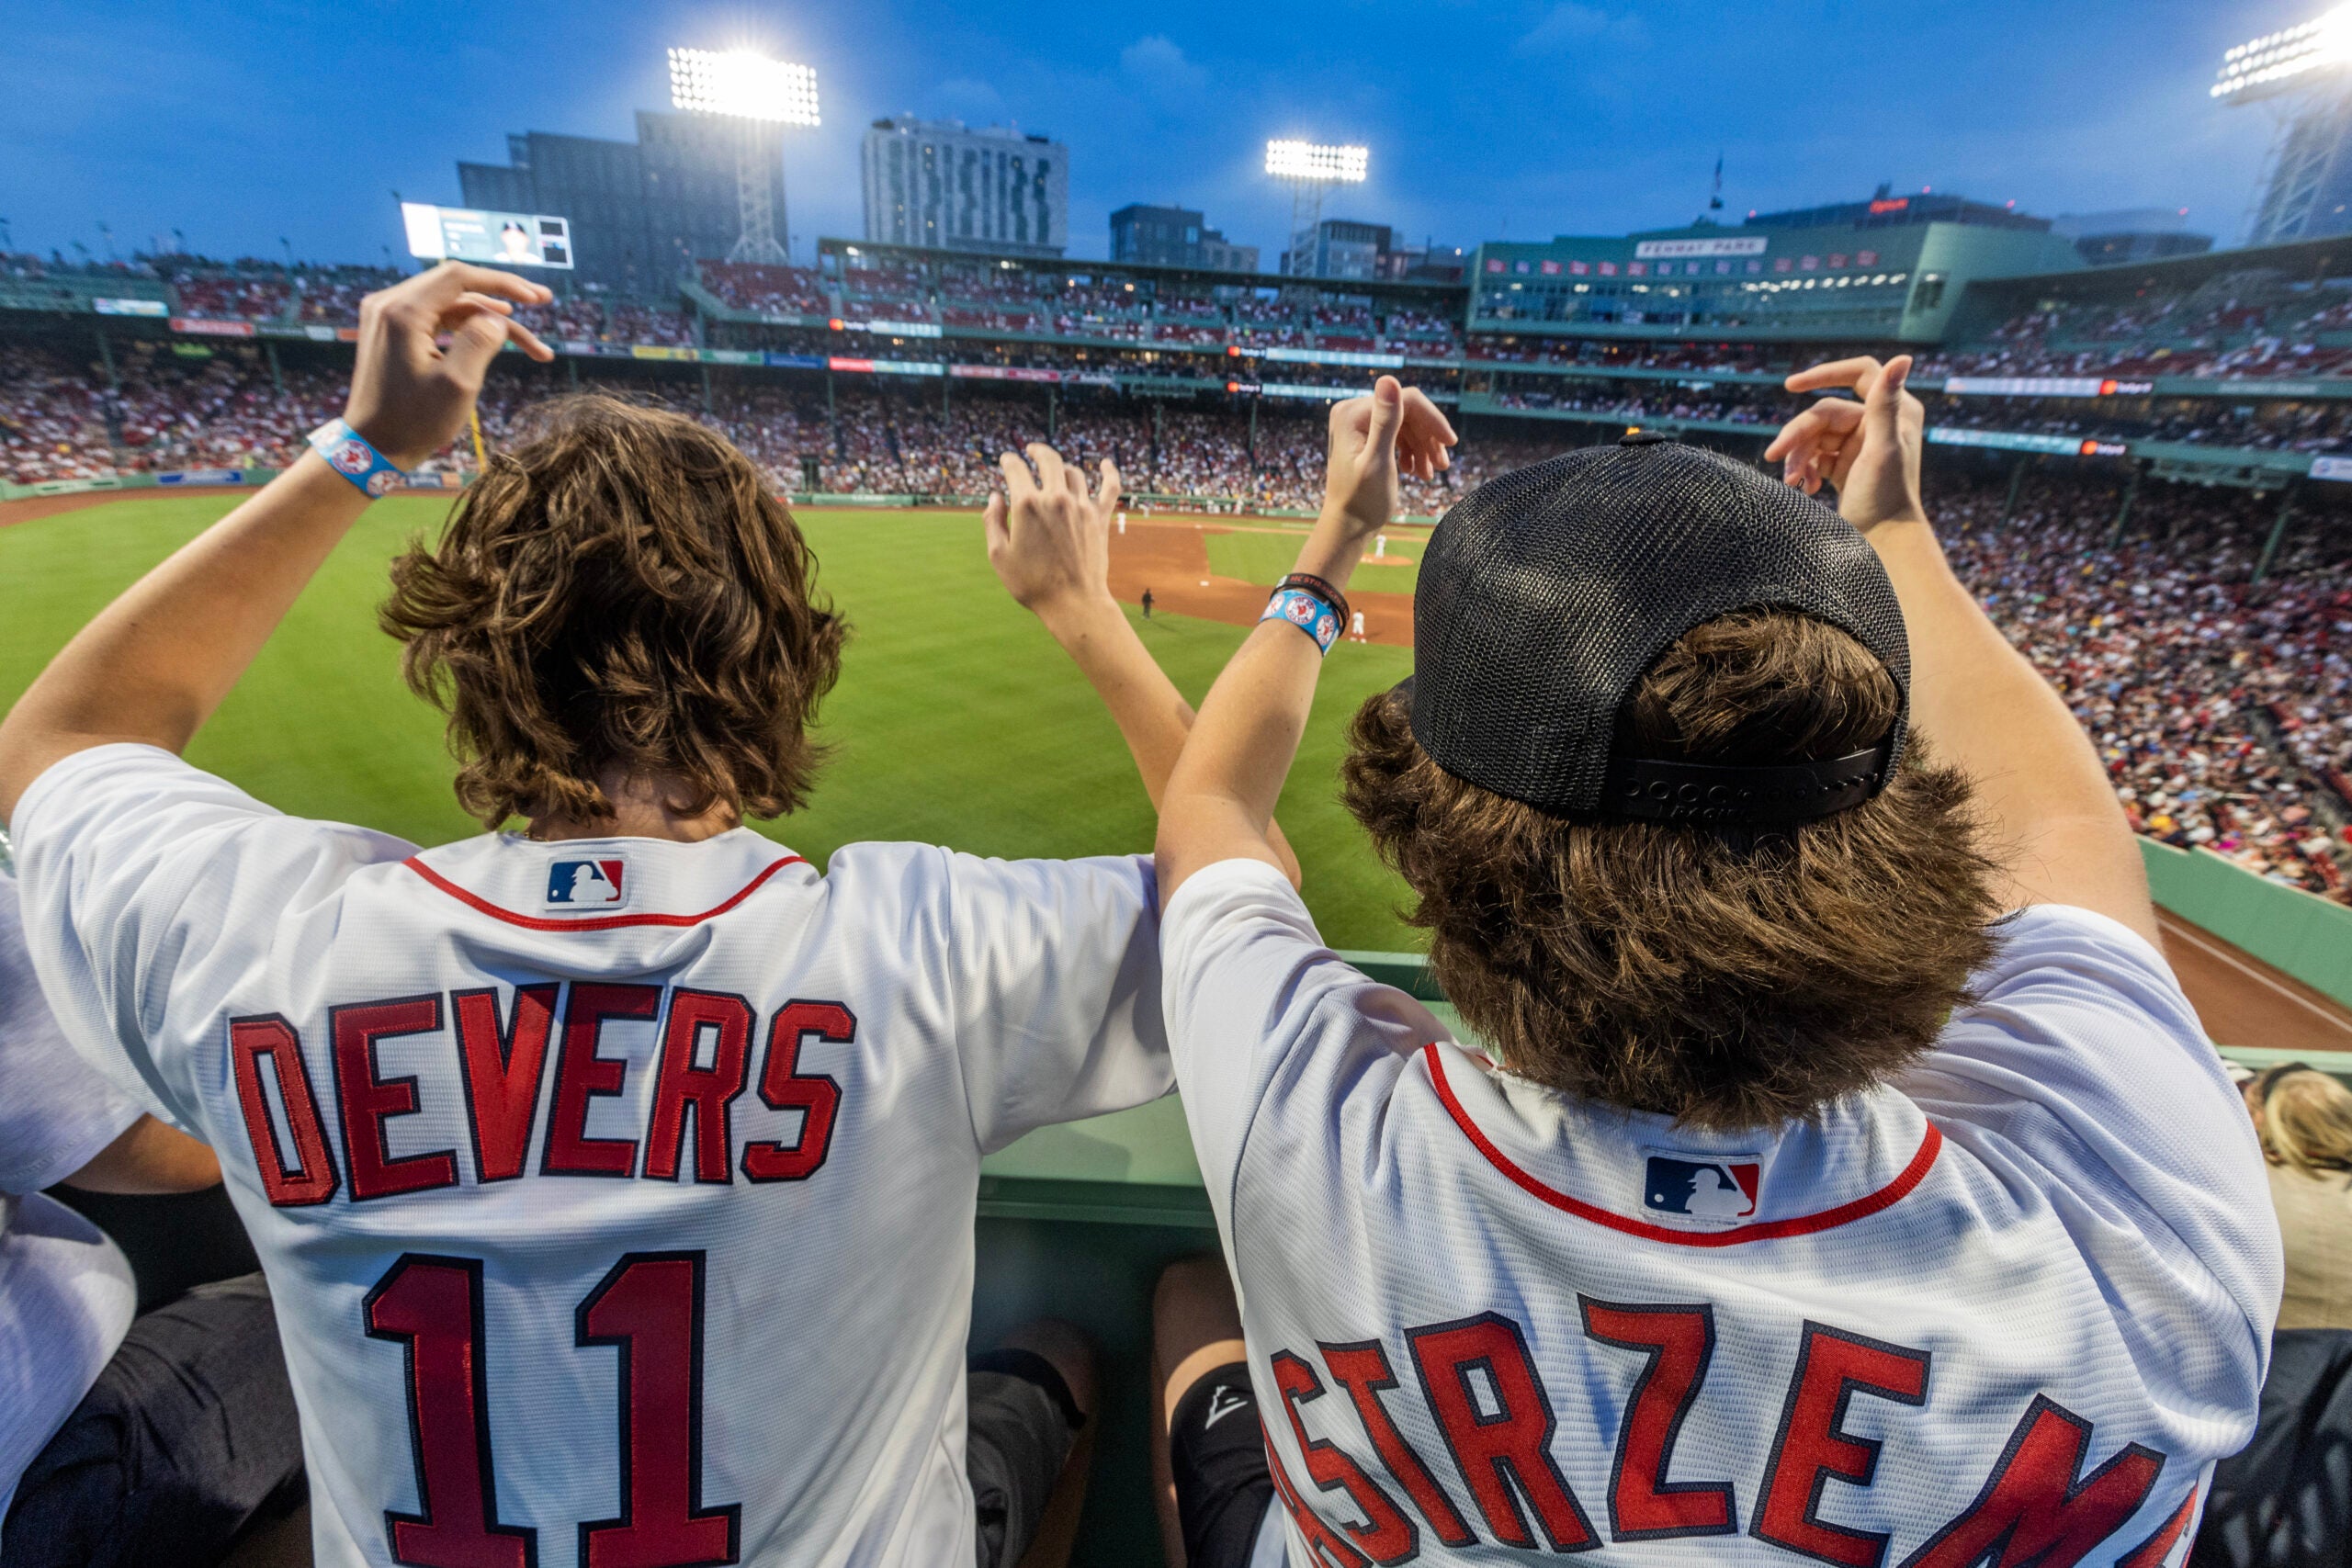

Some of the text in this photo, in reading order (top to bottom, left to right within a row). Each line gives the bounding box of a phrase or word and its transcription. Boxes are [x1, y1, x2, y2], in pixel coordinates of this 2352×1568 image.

[1713, 239, 1756, 252] PARK
[230, 980, 856, 1206] DEVERS
[361, 1249, 741, 1568] 11
